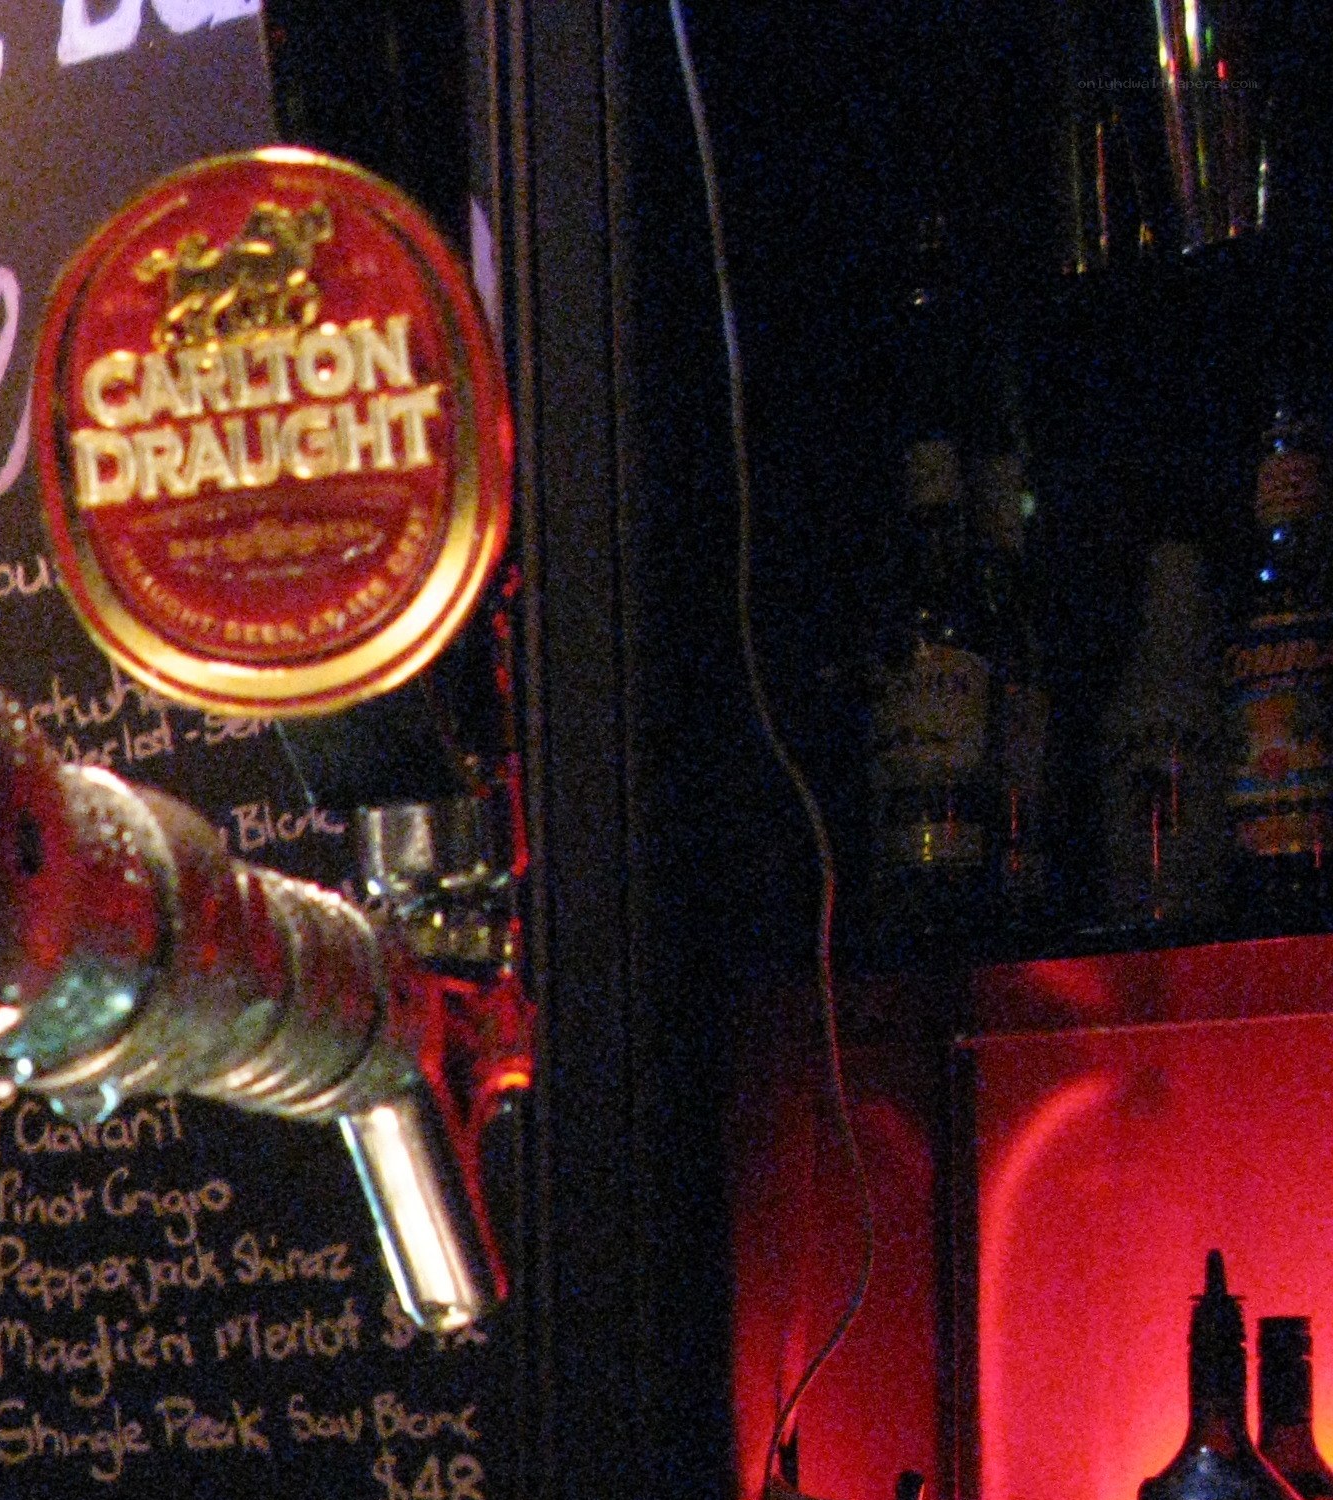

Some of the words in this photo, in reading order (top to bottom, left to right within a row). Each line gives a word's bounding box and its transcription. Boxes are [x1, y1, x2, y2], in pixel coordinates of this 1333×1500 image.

[82, 315, 416, 427] CARLTON
[70, 384, 444, 508] DRAUGHT
[102, 1166, 233, 1247] Grigio
[233, 1231, 354, 1285] Shiraz
[214, 1298, 362, 1361] Merlot
[154, 1395, 271, 1453] Peak
